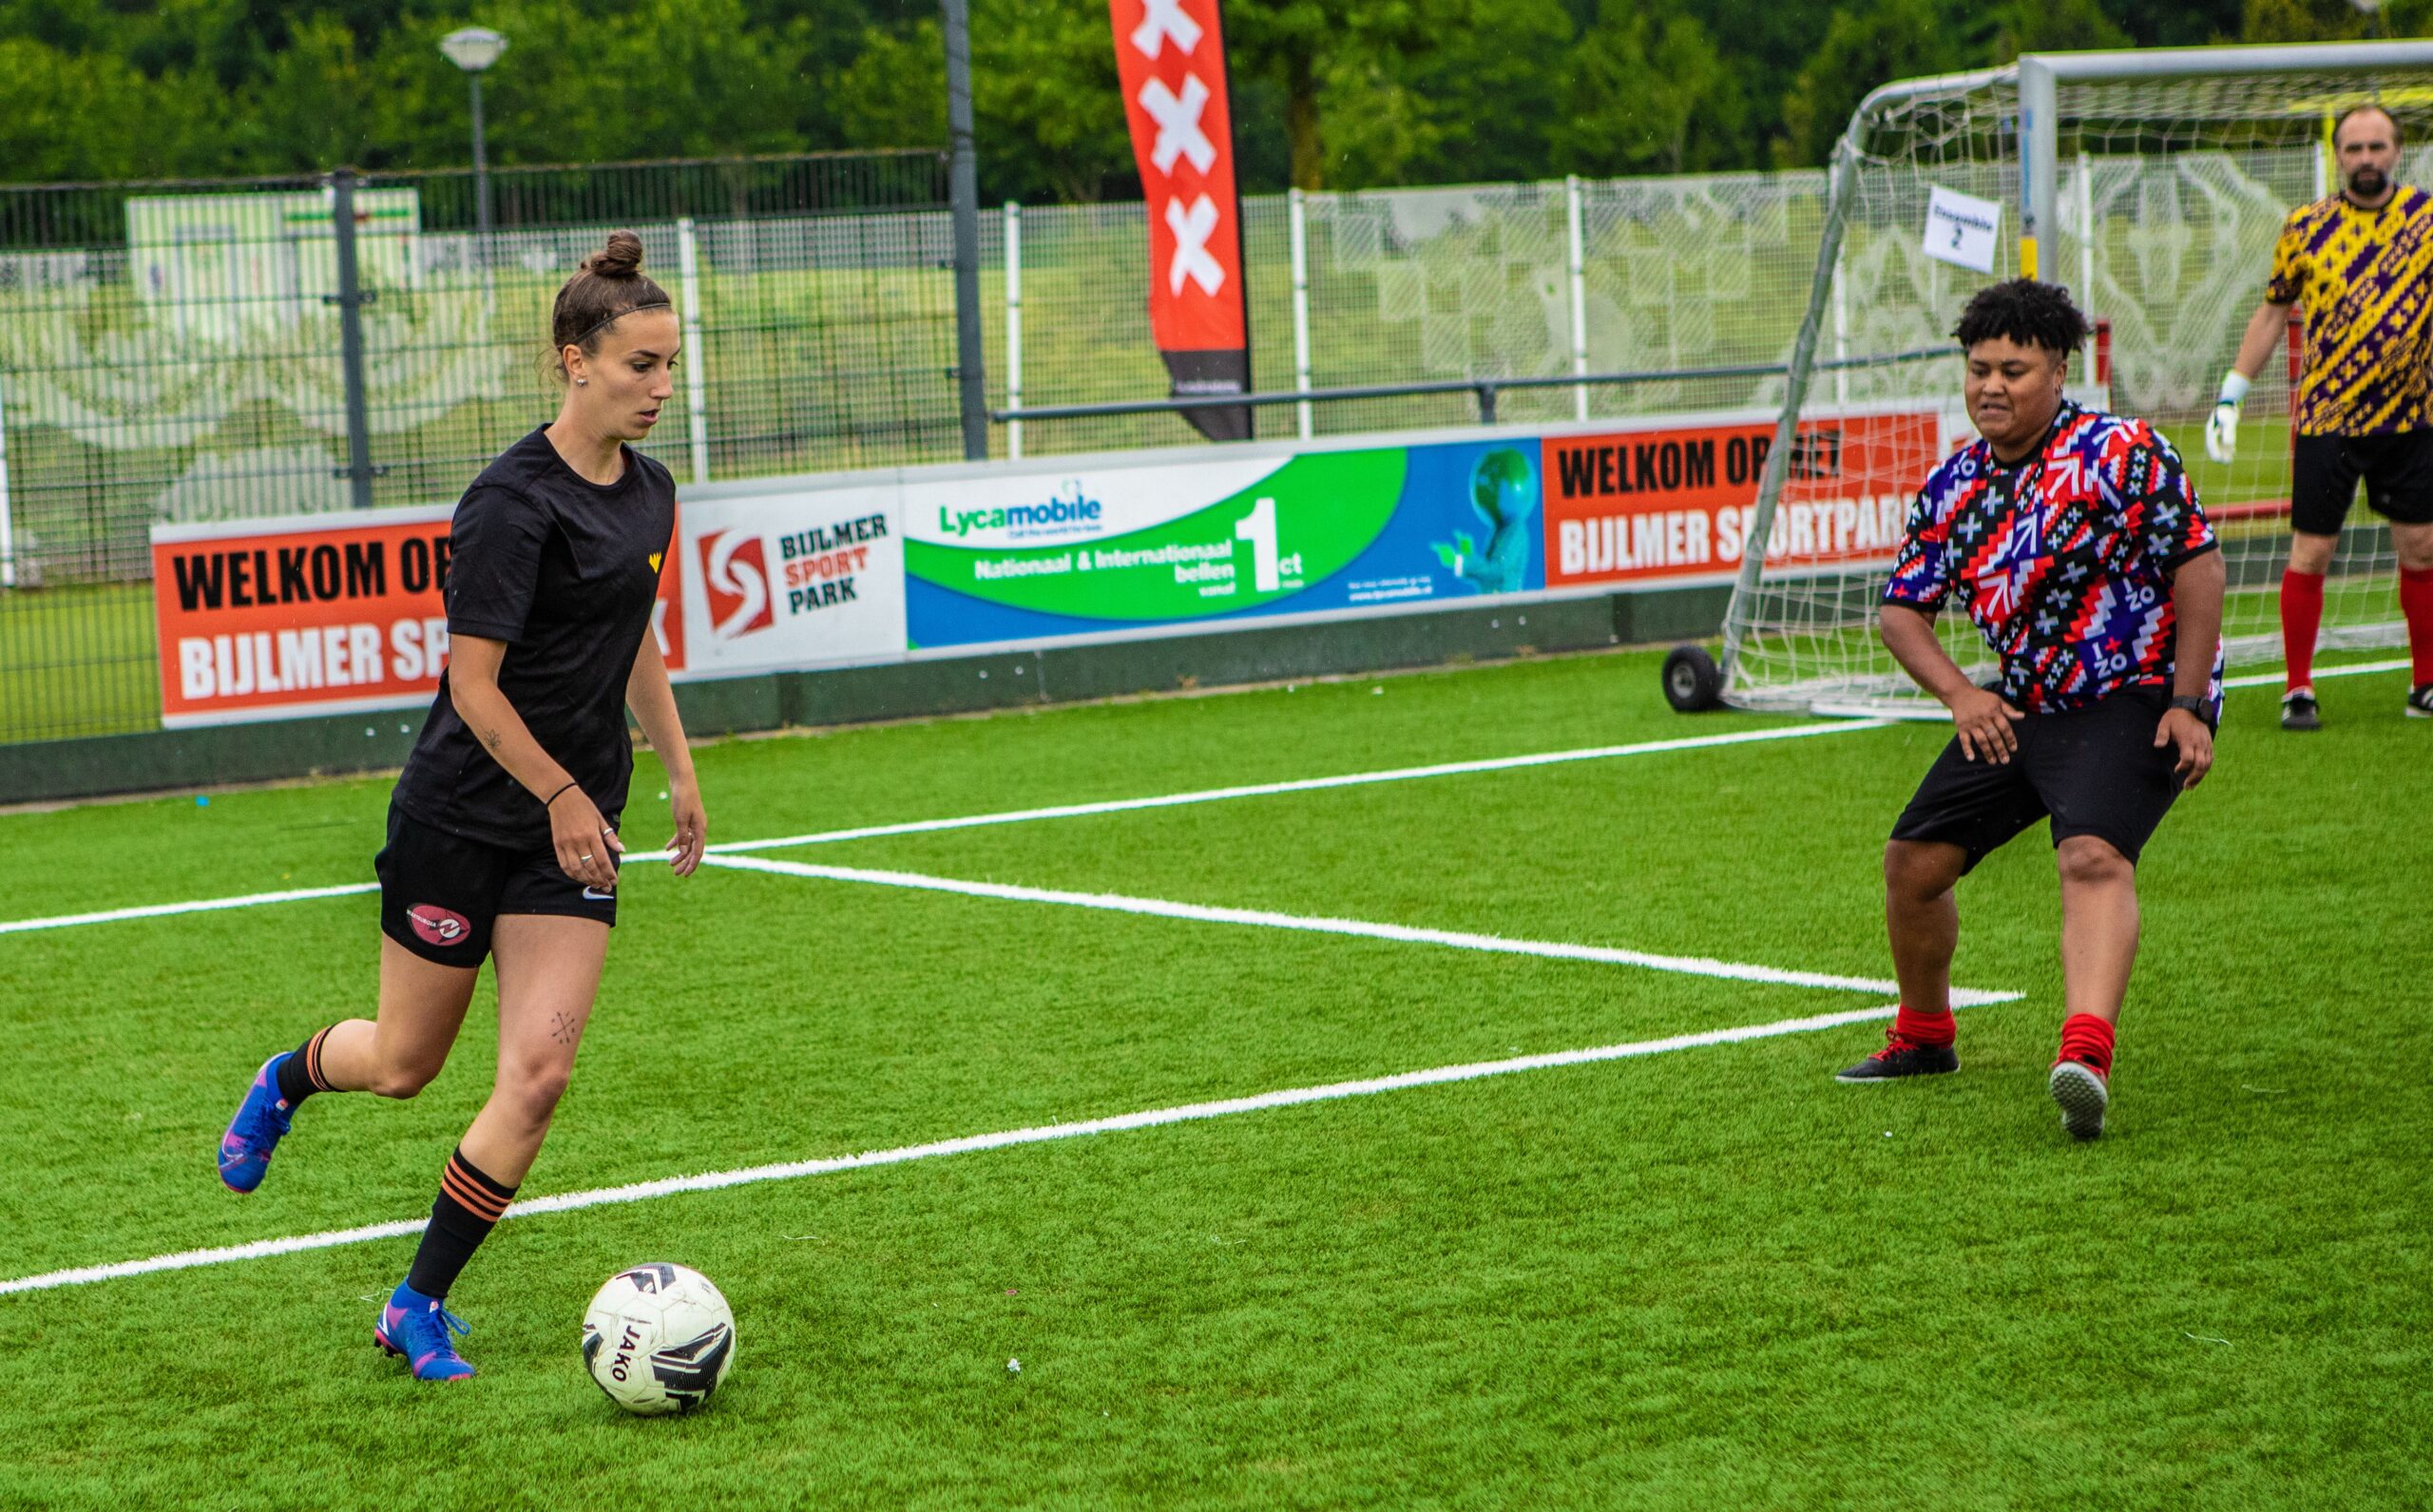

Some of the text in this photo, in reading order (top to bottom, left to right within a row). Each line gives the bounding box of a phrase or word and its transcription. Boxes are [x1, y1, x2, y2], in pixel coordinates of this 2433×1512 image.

[1558, 438, 1716, 498] WELKOM
[1726, 434, 1773, 488] OP
[780, 513, 888, 561] BIJLMER
[939, 493, 1101, 537] Lycamobile
[1560, 508, 1712, 575] BIJLMER
[785, 546, 868, 587] SPORT
[974, 538, 1234, 580] Nationaal & Internationaal
[1236, 497, 1279, 592] 1
[173, 541, 387, 612] WELKOM
[789, 577, 858, 615] PARK
[1175, 562, 1235, 584] bellen
[178, 622, 385, 701] BIJLMER
[611, 1324, 641, 1383] JAKO
